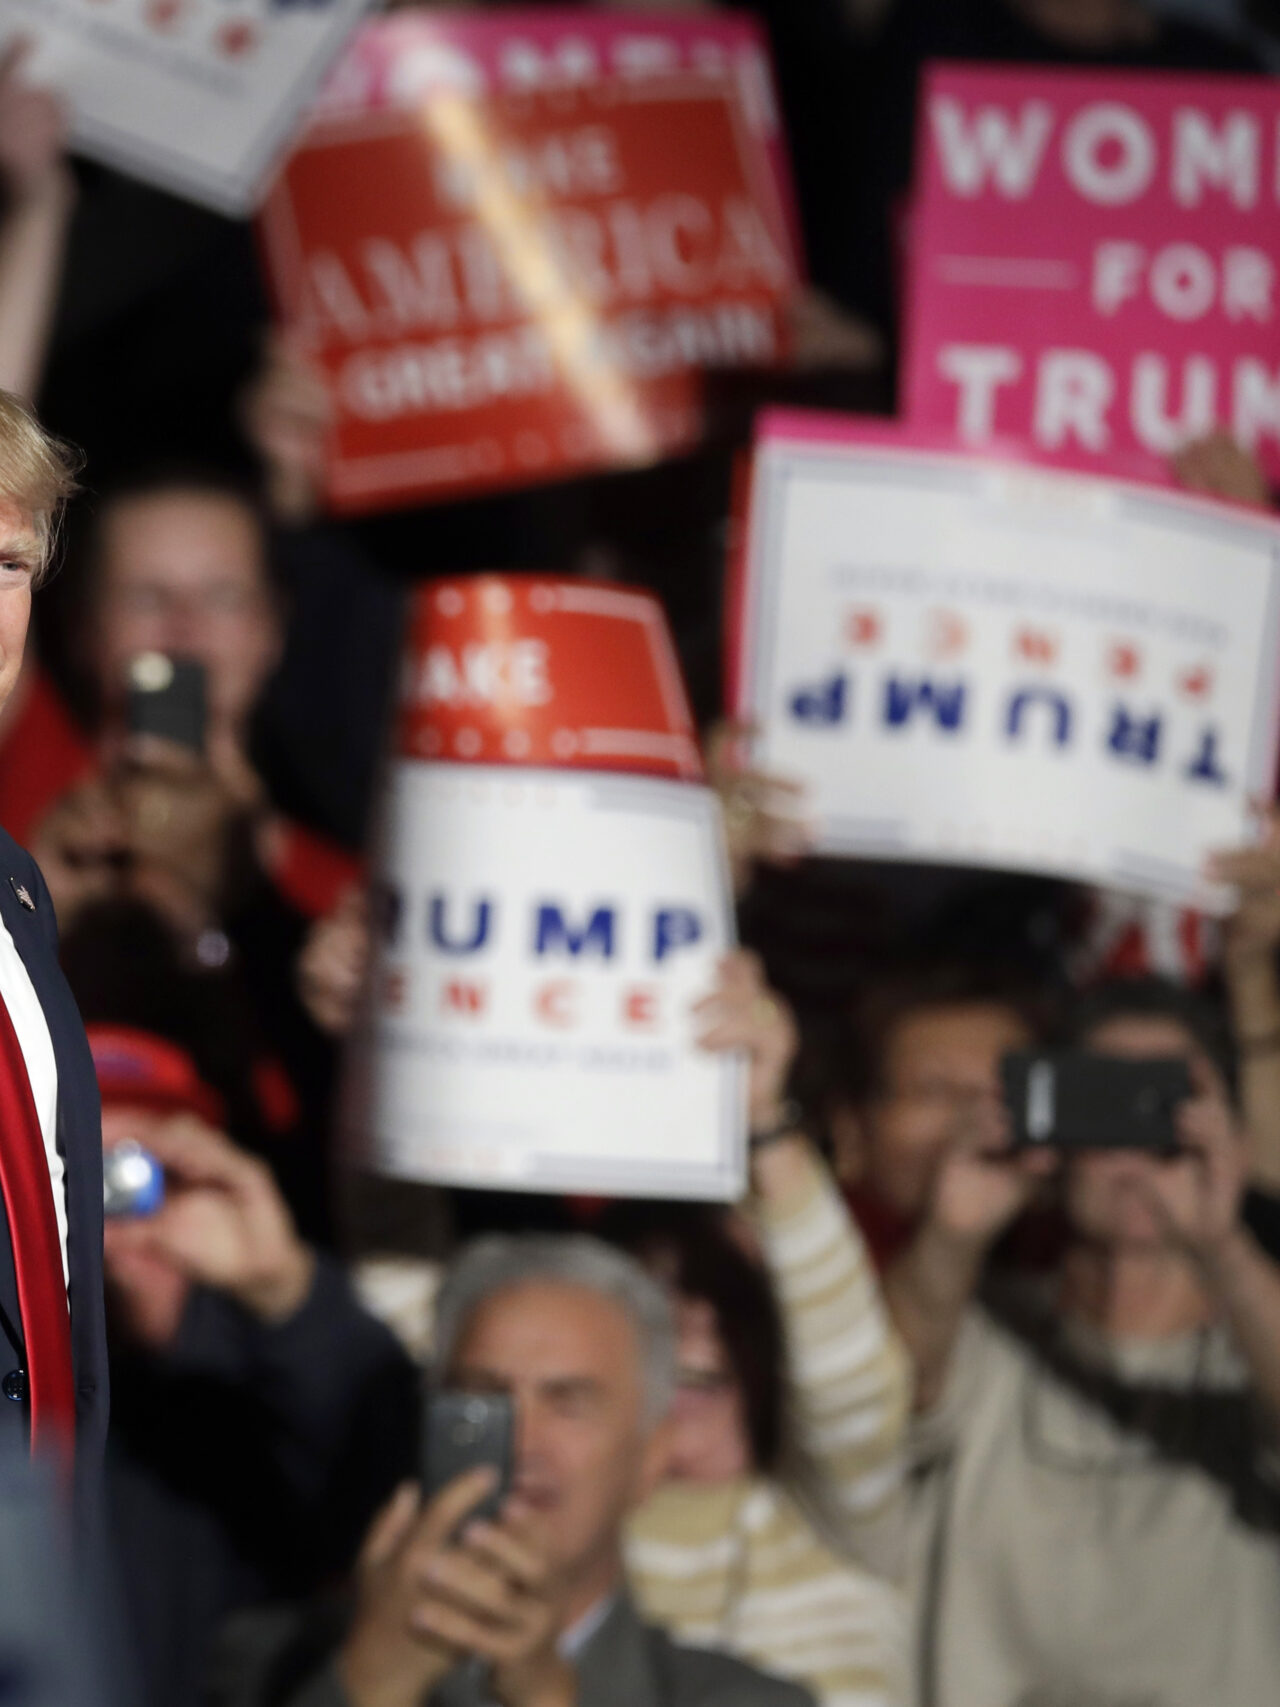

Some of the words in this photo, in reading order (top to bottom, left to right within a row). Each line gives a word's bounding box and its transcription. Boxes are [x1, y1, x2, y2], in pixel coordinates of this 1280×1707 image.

[930, 93, 1280, 212] WOM
[1090, 236, 1274, 325] FOR
[414, 636, 556, 709] AKE
[841, 601, 1216, 699] PENCE
[788, 666, 1229, 790] TRUMP
[386, 966, 664, 1036] ENCE
